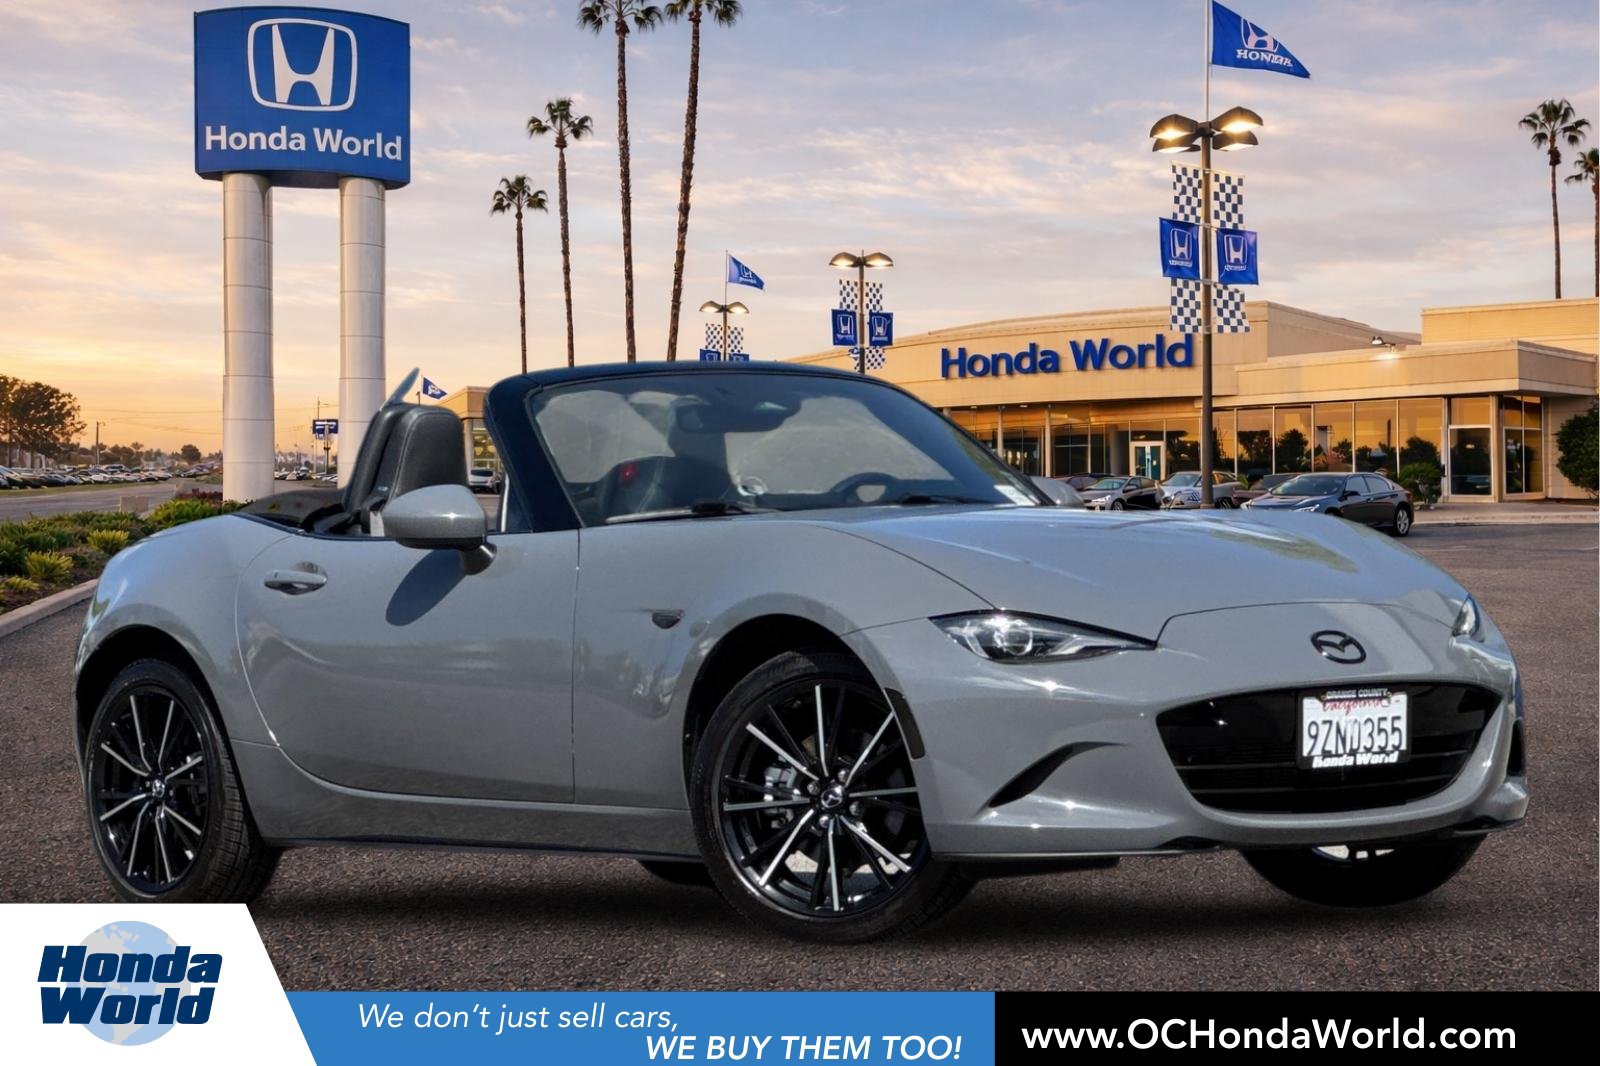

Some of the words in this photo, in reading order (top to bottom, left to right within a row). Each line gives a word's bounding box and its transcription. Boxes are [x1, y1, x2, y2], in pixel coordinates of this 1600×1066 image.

[205, 125, 306, 151] Honda
[313, 127, 402, 161] World
[941, 342, 1060, 378] Honda
[1069, 333, 1194, 371] World
[1326, 689, 1357, 699] ORANGE
[1358, 688, 1388, 698] COUNTY
[1312, 754, 1355, 769] Honda
